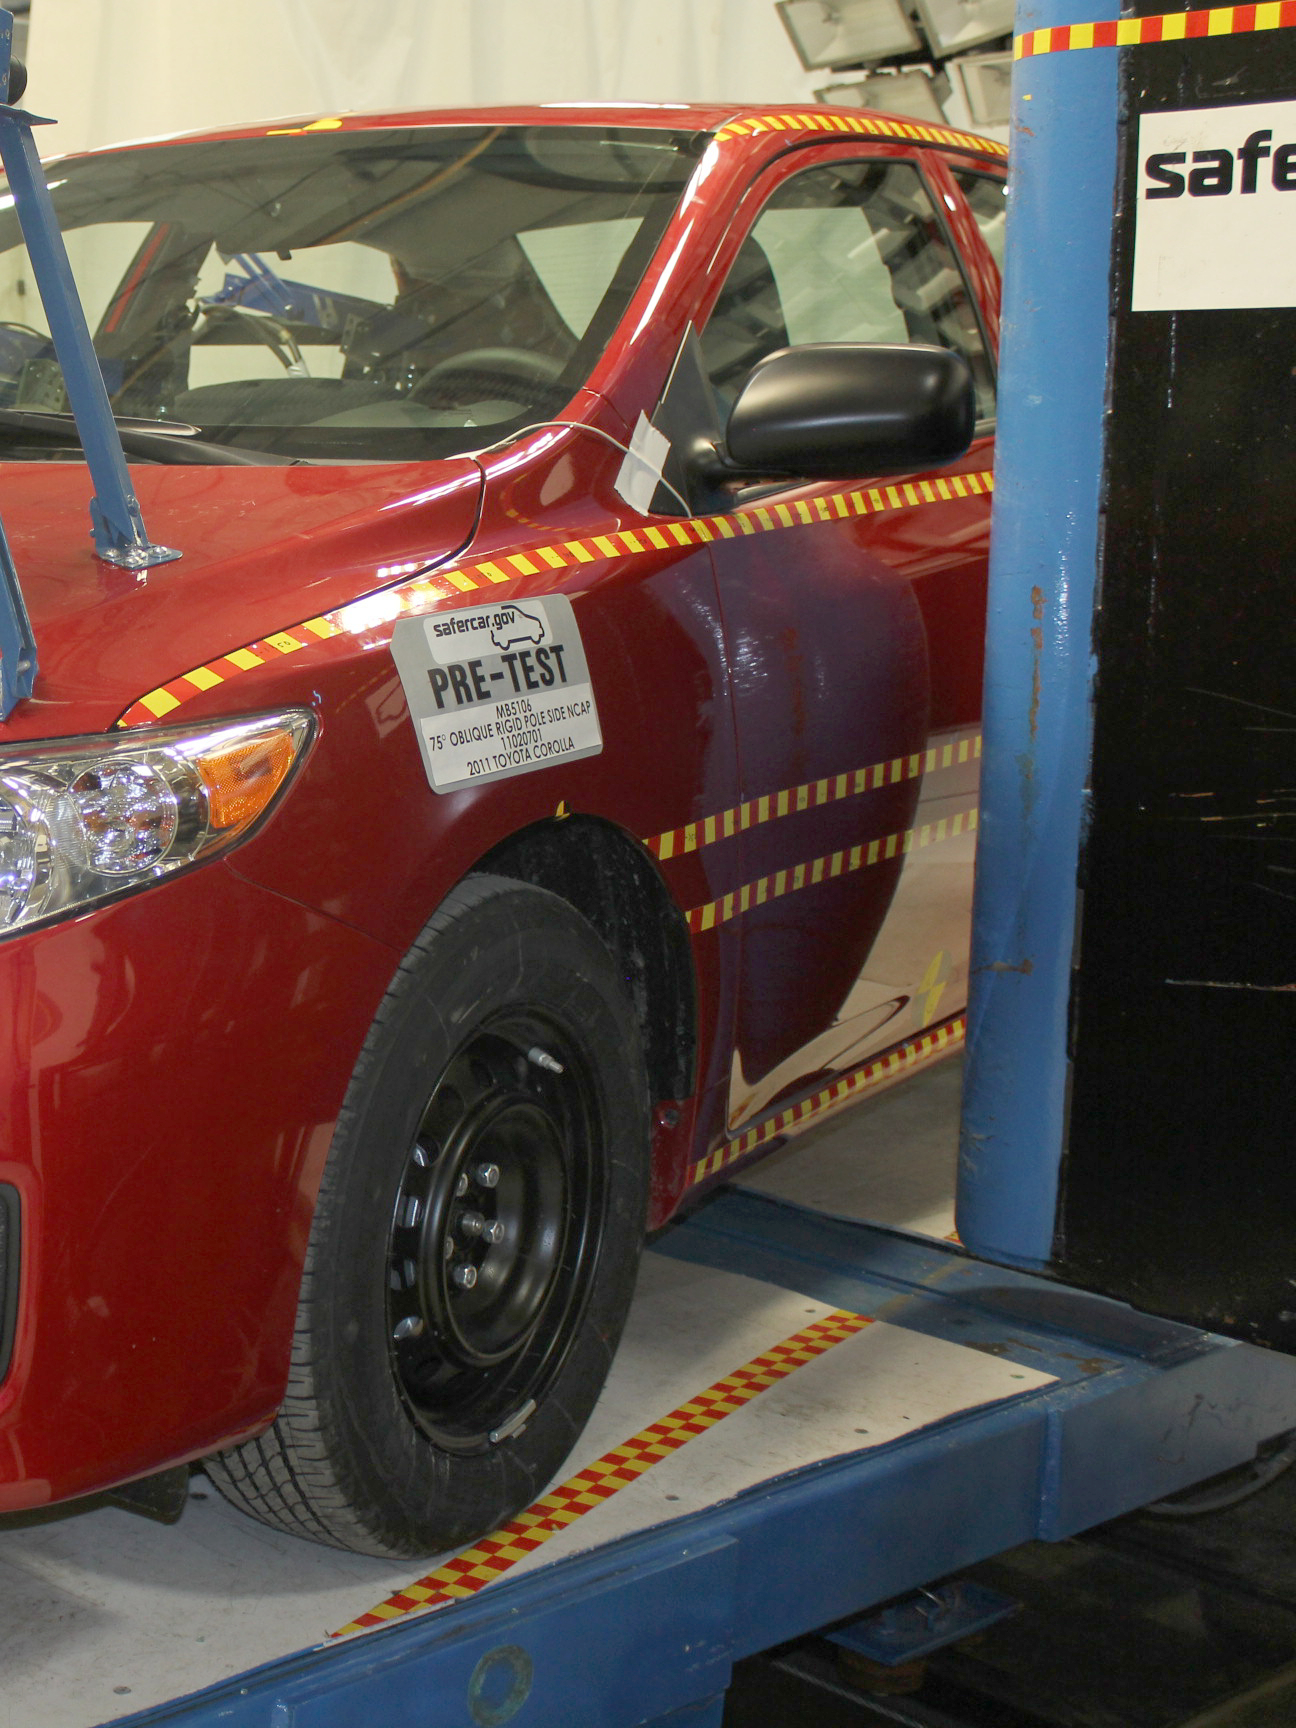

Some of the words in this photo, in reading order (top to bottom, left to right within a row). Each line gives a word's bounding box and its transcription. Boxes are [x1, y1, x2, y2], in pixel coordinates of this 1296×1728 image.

[433, 611, 515, 638] safercar.gov
[427, 644, 567, 709] PRE-TEST
[449, 723, 494, 747] OBLIQUE
[495, 716, 523, 737] RIGID
[524, 710, 546, 729] POLE
[548, 705, 567, 724] SIDE
[567, 700, 591, 720] NCAP
[495, 699, 532, 720] MB5106
[500, 728, 543, 750] 11020701
[467, 757, 492, 776] 2011
[492, 746, 533, 770] TOYOTA
[533, 736, 575, 759] COROLLA
